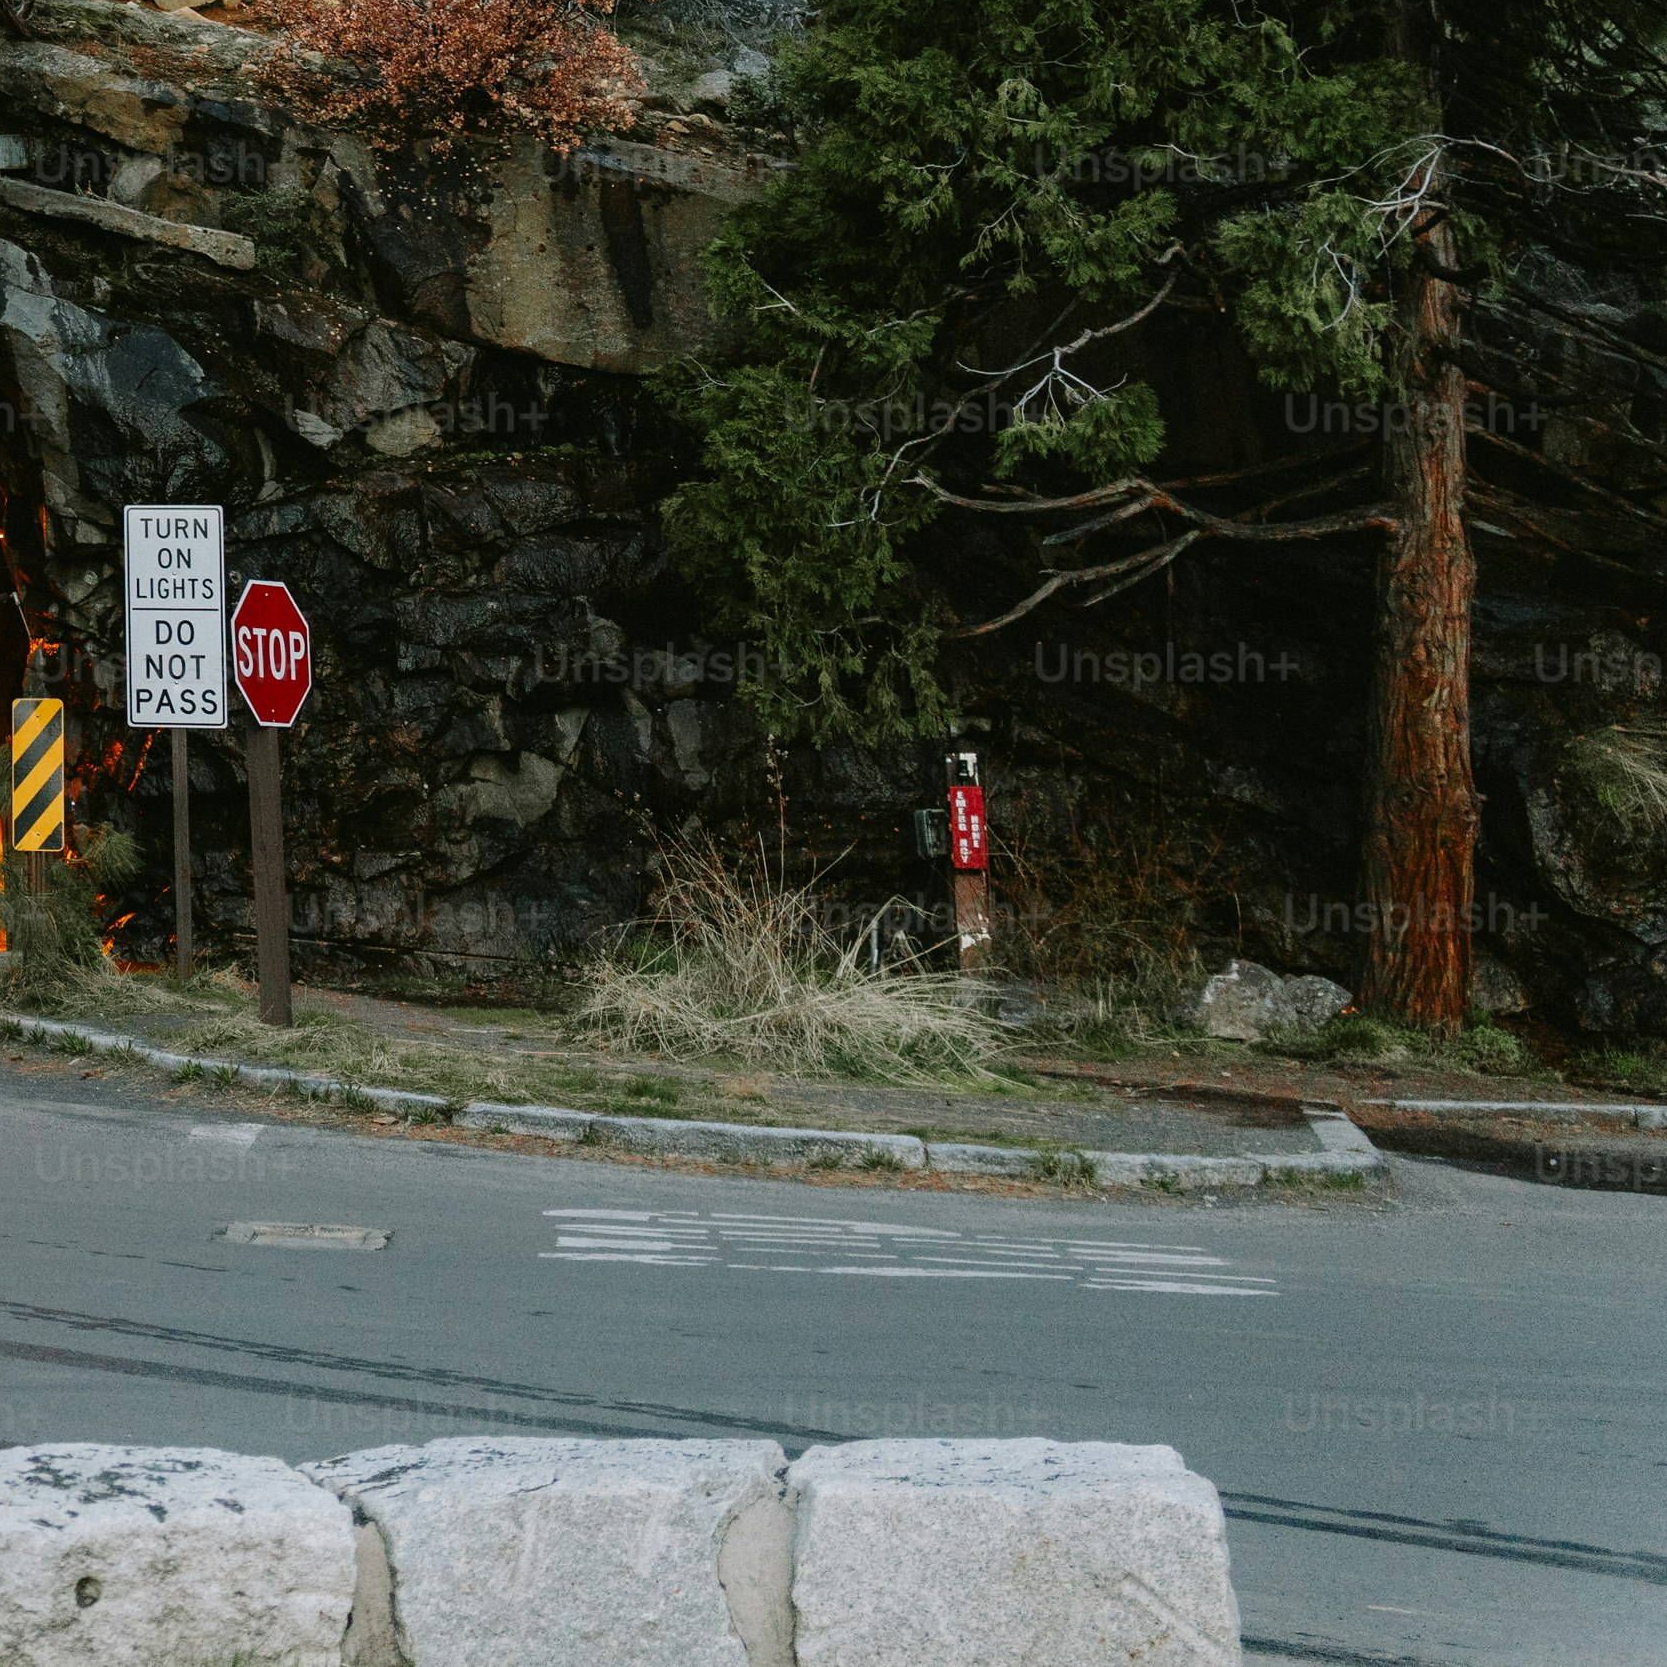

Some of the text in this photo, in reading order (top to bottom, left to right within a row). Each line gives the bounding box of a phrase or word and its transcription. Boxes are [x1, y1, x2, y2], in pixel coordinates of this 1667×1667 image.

[140, 518, 208, 539] TURN
[158, 548, 191, 569] ON
[136, 578, 214, 599] LIGHTS
[155, 620, 195, 645] DO
[238, 625, 305, 681] STOP
[146, 654, 206, 680] NOT
[136, 688, 218, 715] PASS
[955, 790, 969, 864] EMERGNCY
